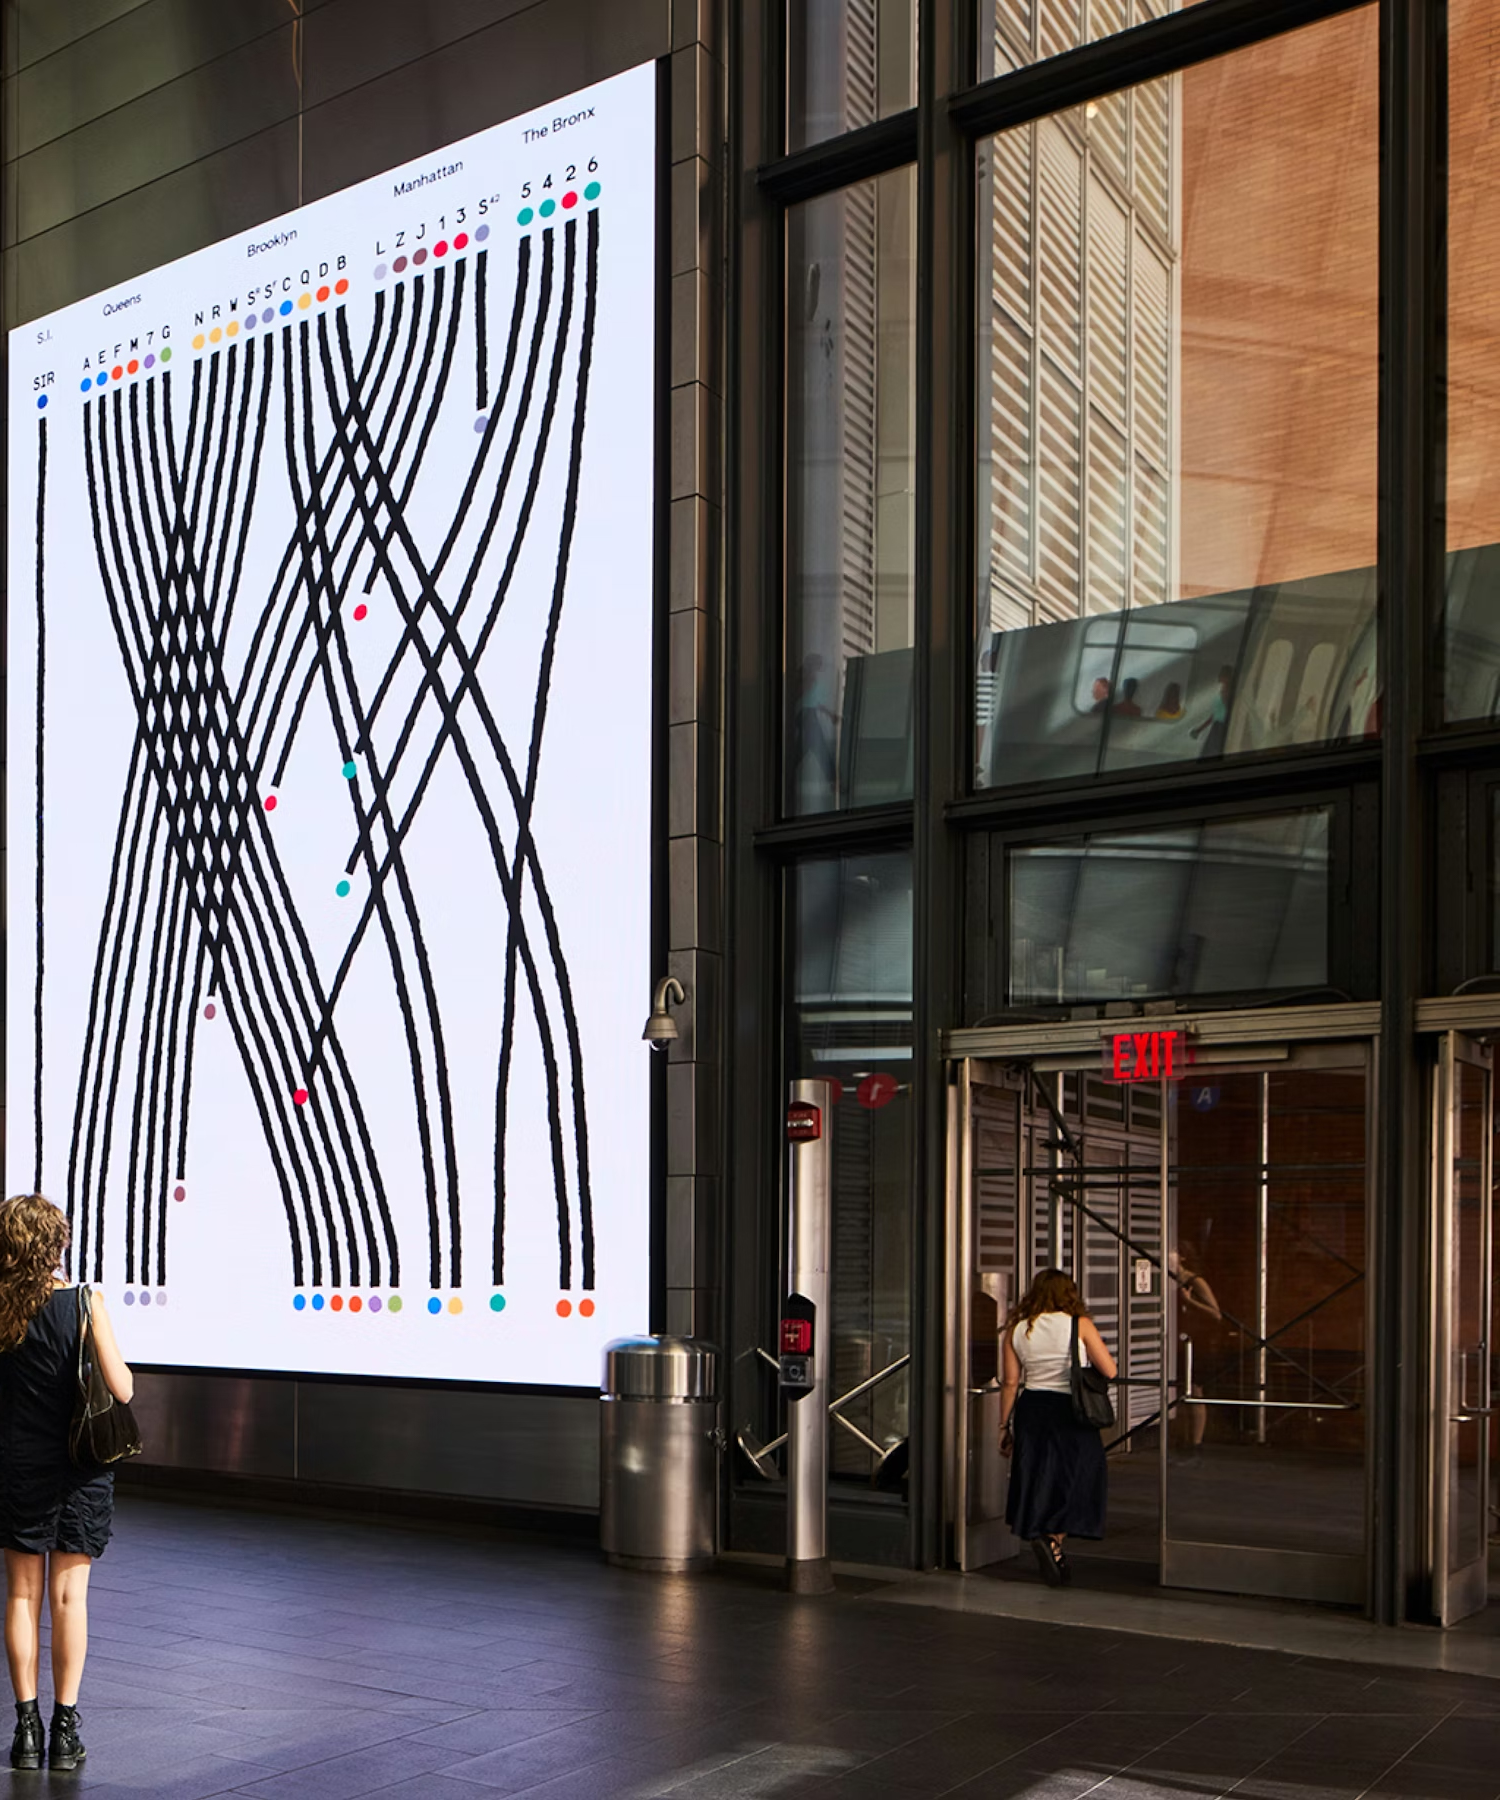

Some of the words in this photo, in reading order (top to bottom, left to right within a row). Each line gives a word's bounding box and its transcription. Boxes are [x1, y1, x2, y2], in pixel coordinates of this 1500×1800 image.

[523, 127, 549, 144] The
[552, 107, 596, 133] Bronx
[392, 160, 464, 197] Manhattan
[520, 181, 531, 199] 5
[542, 173, 553, 189] 4
[565, 164, 577, 183] 2
[587, 156, 599, 173] 6
[246, 228, 298, 258] Brooklyn
[376, 241, 386, 256] L
[395, 231, 405, 249] Z
[415, 223, 426, 240] J
[439, 215, 445, 230] 1
[456, 207, 467, 224] 3
[102, 292, 142, 317] Queens
[194, 311, 204, 326] N
[211, 304, 221, 320] R
[229, 297, 238, 313] W
[282, 276, 291, 292] C
[300, 269, 310, 285] Q
[319, 262, 329, 278] D
[336, 254, 347, 271] B
[36, 330, 53, 346] S.I.
[83, 357, 91, 371] A
[98, 349, 106, 365] E
[113, 343, 122, 358] F
[129, 337, 139, 352] M
[146, 330, 155, 345] 7
[161, 325, 171, 340] G
[33, 370, 55, 391] SIR
[1112, 1030, 1178, 1079] EXIT
